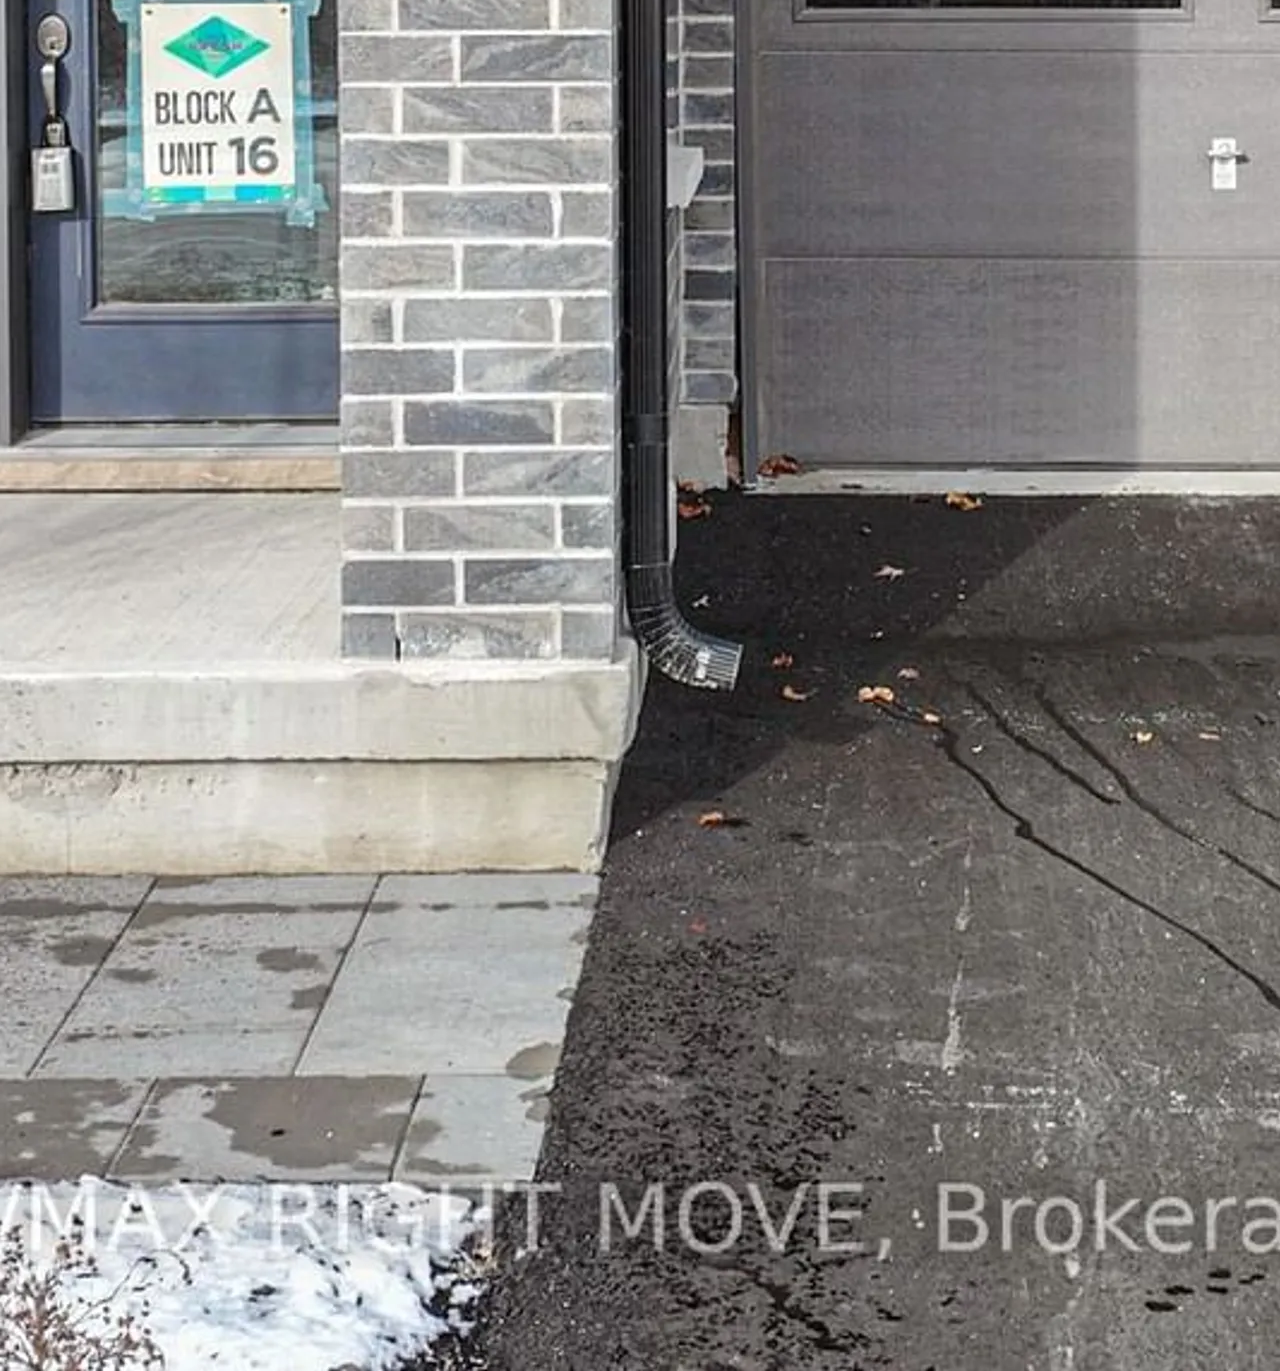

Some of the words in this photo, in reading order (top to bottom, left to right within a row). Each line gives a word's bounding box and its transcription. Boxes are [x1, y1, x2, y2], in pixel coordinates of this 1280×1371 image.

[154, 91, 236, 124] BLOCK
[247, 88, 281, 123] A
[158, 142, 218, 176] UNIT
[228, 136, 280, 176] 16
